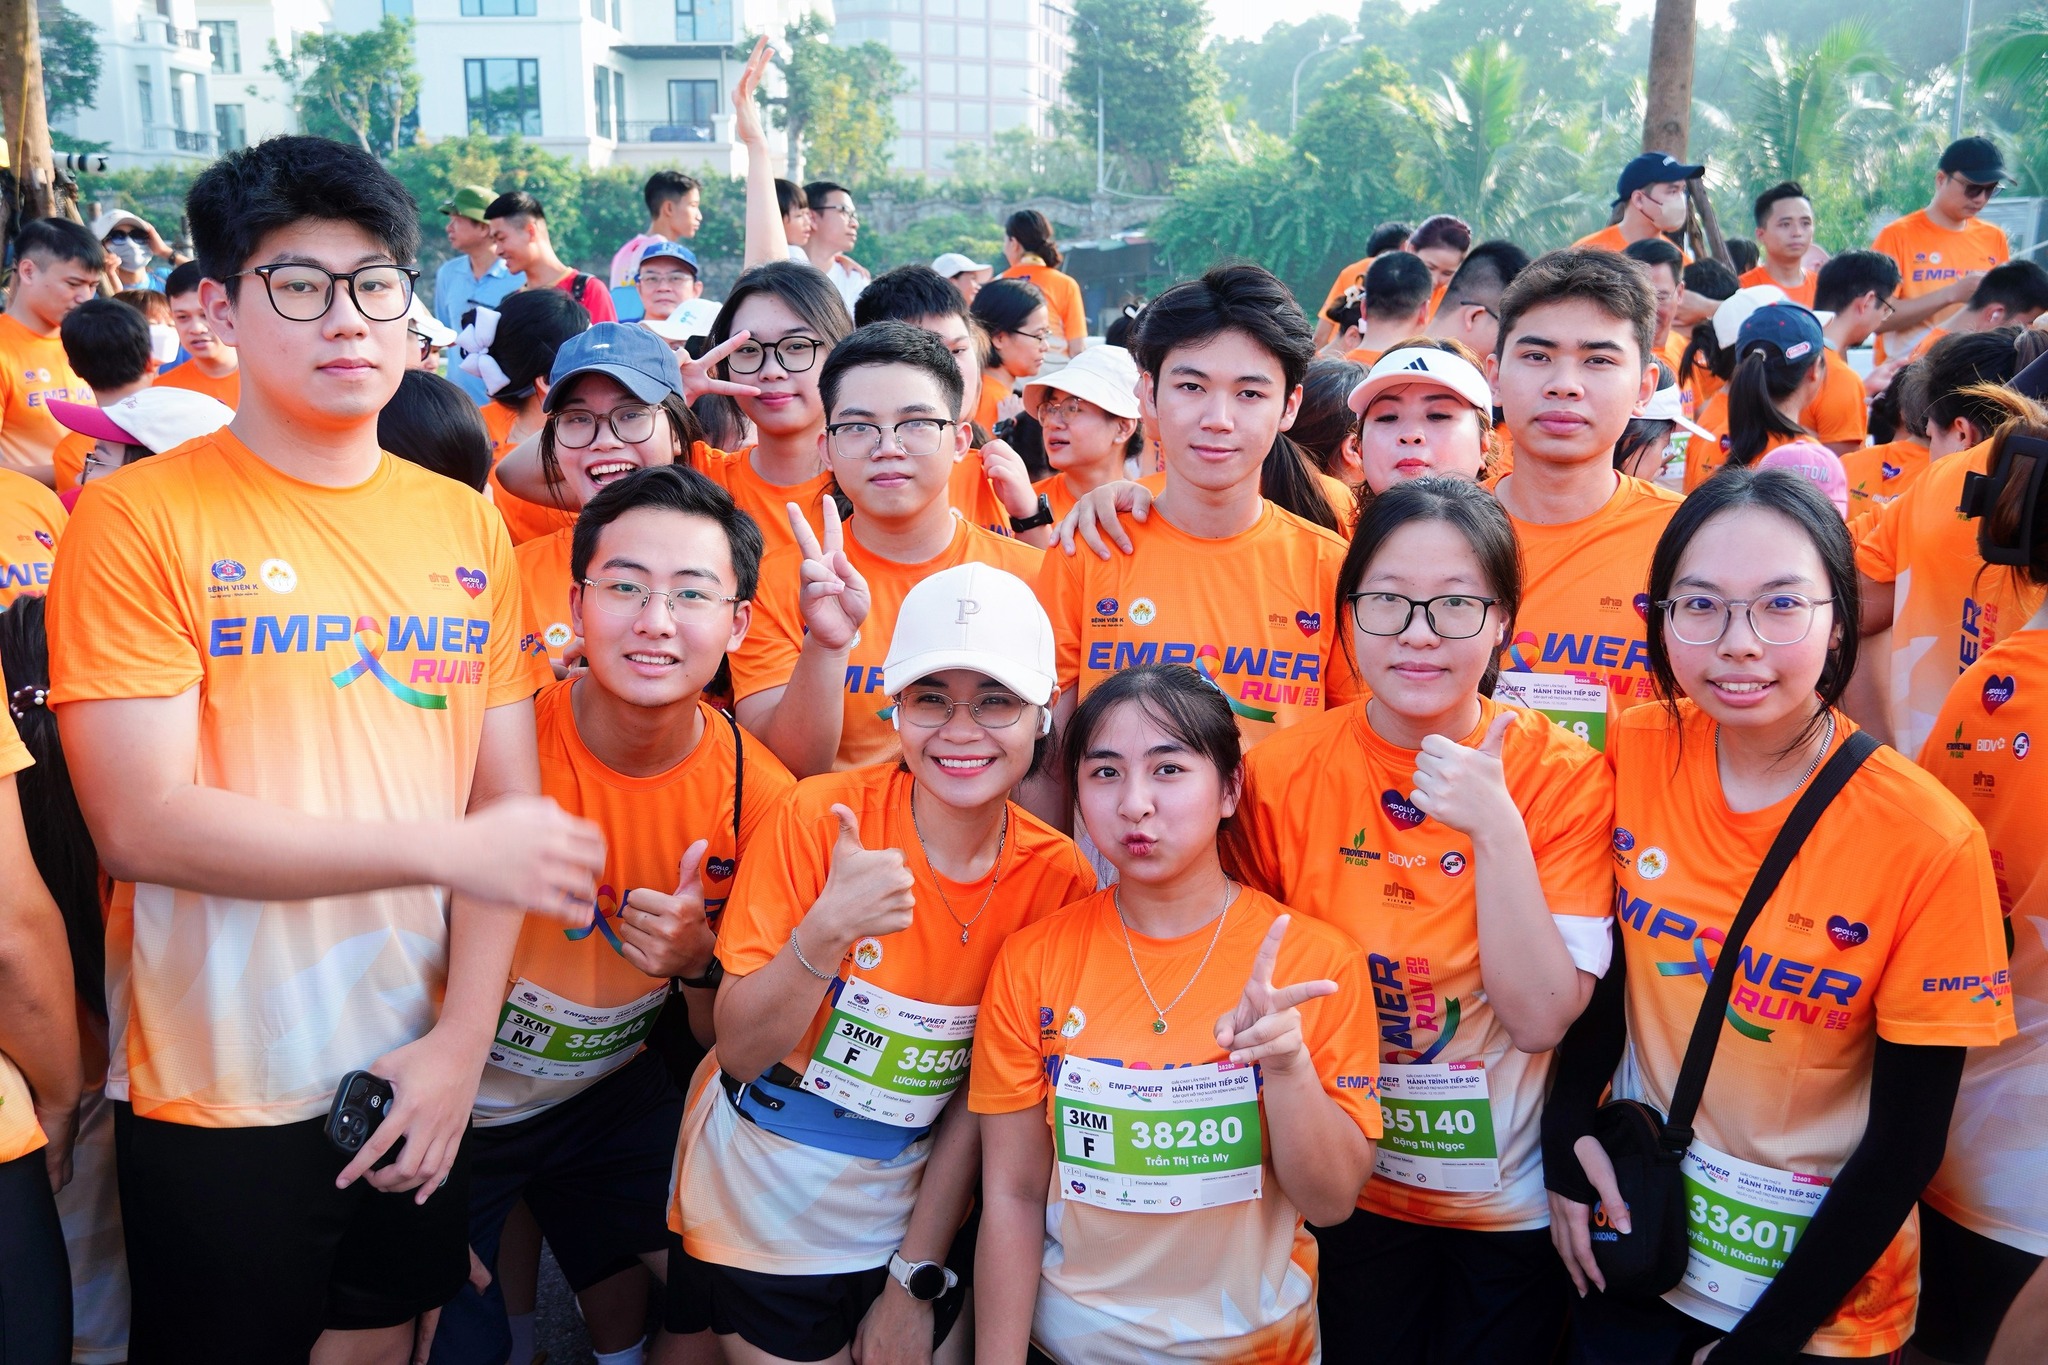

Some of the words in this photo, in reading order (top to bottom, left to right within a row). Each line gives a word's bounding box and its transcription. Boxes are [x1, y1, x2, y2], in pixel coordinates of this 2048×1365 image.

[955, 598, 982, 625] P
[410, 659, 472, 685] RUN
[1240, 681, 1300, 705] RUN
[1976, 739, 1998, 752] BIDV
[1388, 803, 1416, 814] APOLLO
[1392, 810, 1421, 823] care
[1339, 847, 1380, 860] PETROVIETNAM
[1345, 856, 1354, 865] PV
[1355, 858, 1369, 867] GAS
[1388, 851, 1415, 869] BIDV
[1831, 926, 1859, 936] APOLLO
[1732, 985, 1823, 1025] RUN
[513, 1014, 551, 1036] 3KM
[565, 1016, 646, 1049] 35646
[510, 1029, 535, 1048] M
[842, 1022, 884, 1049] 3KM
[843, 1047, 861, 1065] F
[892, 1074, 926, 1088] LƯƠNG
[928, 1079, 941, 1089] THỊ
[1108, 1081, 1163, 1093] EMPOWER
[1171, 1084, 1194, 1092] HÀNH
[1195, 1081, 1217, 1090] TRÌNH
[1219, 1076, 1233, 1087] TIẾP
[1235, 1075, 1249, 1085] SỨC
[1406, 1077, 1427, 1085] HÀNH
[1428, 1077, 1449, 1085] TRÌNH
[1450, 1075, 1464, 1084] TIẾP
[1465, 1075, 1480, 1083] SỨC
[1069, 1109, 1107, 1130] 3KM
[1382, 1108, 1476, 1135] 35140
[1130, 1116, 1243, 1149] 38280
[1083, 1137, 1095, 1158] F
[1393, 1136, 1419, 1149] Đặng
[1420, 1139, 1435, 1151] Thị
[1437, 1142, 1465, 1152] Ngọc
[1145, 1155, 1170, 1166] Trần
[1173, 1153, 1189, 1167] Thị
[1191, 1153, 1209, 1164] Trà
[1212, 1153, 1229, 1164] My
[1738, 1177, 1761, 1189] HÀNH
[1763, 1184, 1786, 1195] TRÌNH
[1788, 1188, 1804, 1197] TIẾP
[1805, 1191, 1822, 1200] SỨC
[1689, 1194, 1797, 1253] 33601
[1686, 1228, 1709, 1246] uyễn
[1712, 1240, 1729, 1256] Thị
[1730, 1245, 1769, 1267] Khánh
